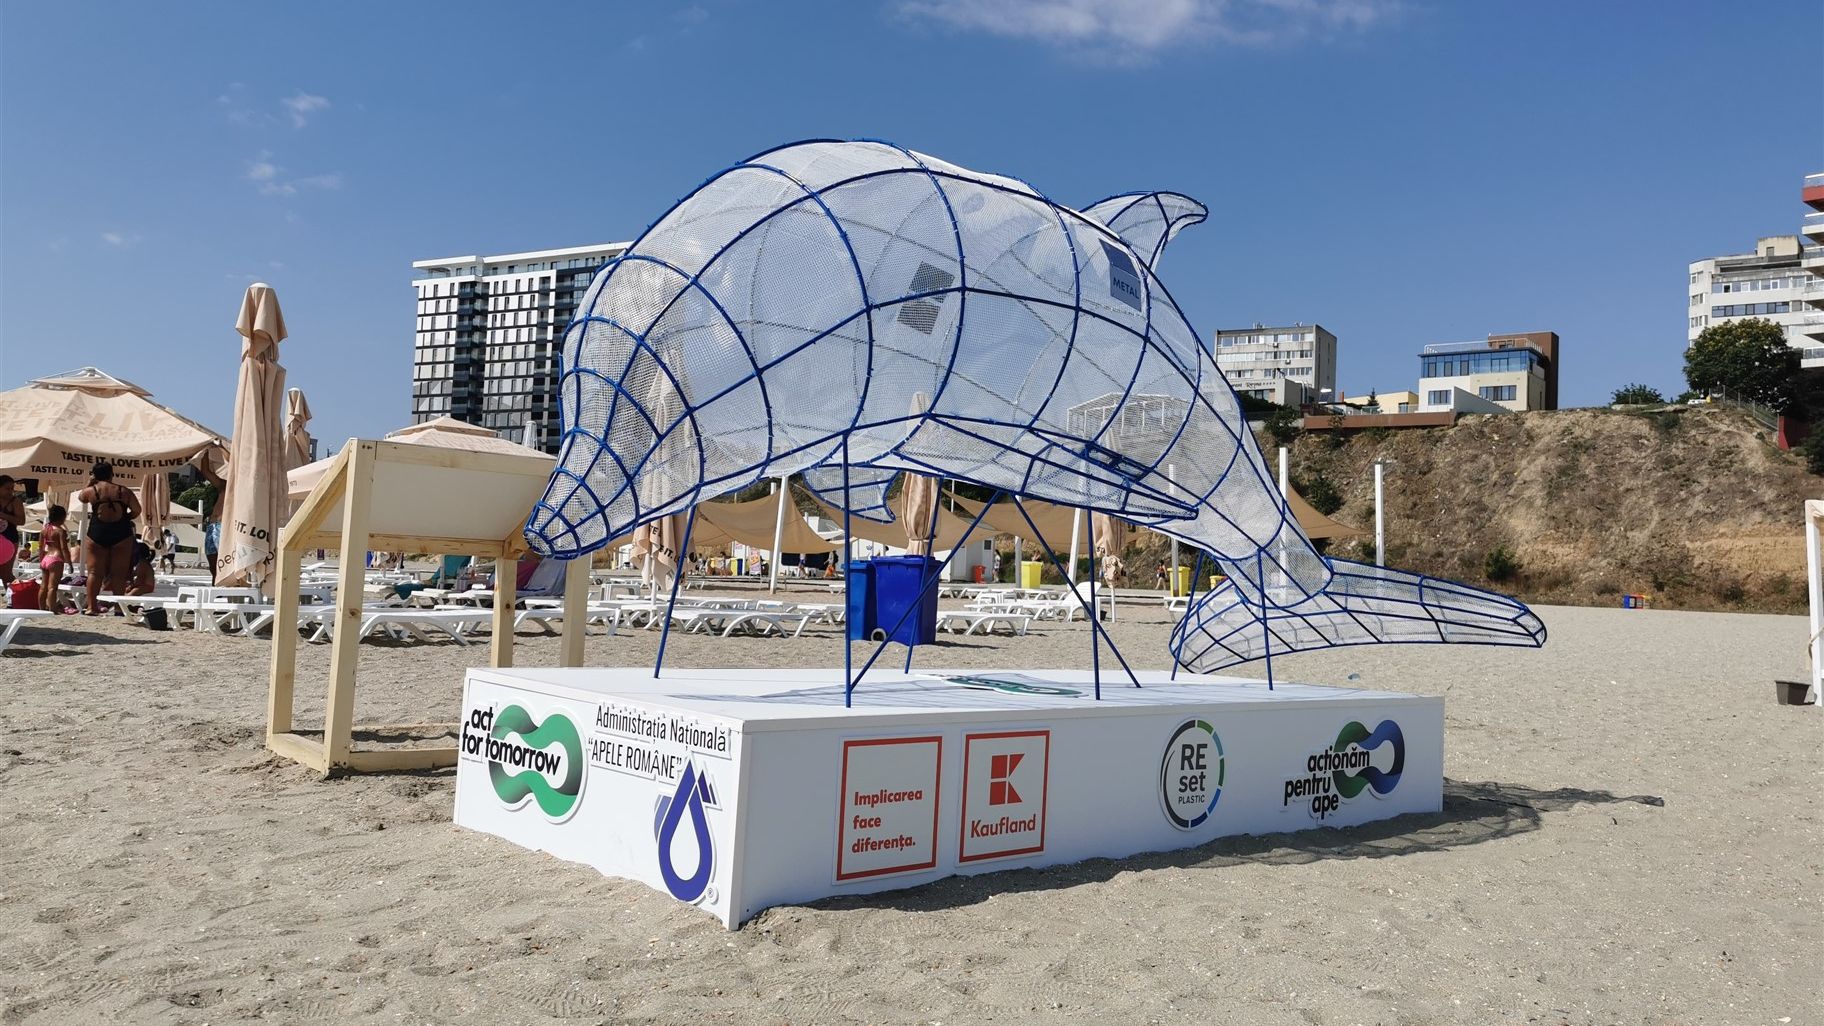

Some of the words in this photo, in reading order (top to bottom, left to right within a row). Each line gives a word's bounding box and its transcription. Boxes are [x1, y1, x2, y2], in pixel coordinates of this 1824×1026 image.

[1113, 277, 1139, 299] METAL
[31, 465, 57, 474] TASTE
[59, 467, 69, 475] IT.
[61, 451, 93, 464] TASTE
[111, 457, 140, 468] LOVE
[143, 459, 156, 468] IT.
[158, 457, 182, 467] LIVE
[471, 706, 493, 731] act
[596, 705, 666, 744] Administrația
[670, 718, 726, 752] Națională
[462, 720, 483, 755] for
[485, 733, 561, 775] tomorrow
[1180, 743, 1208, 770] RE
[1307, 745, 1370, 774] acționăm
[1178, 771, 1206, 792] set
[1284, 773, 1330, 806] pentru
[854, 789, 922, 808] Implicarea
[1178, 794, 1205, 804] PLASTIC
[1312, 794, 1339, 820] ape
[853, 815, 881, 830] face
[970, 814, 1036, 838] Kaufland
[851, 834, 916, 854] diferența.
